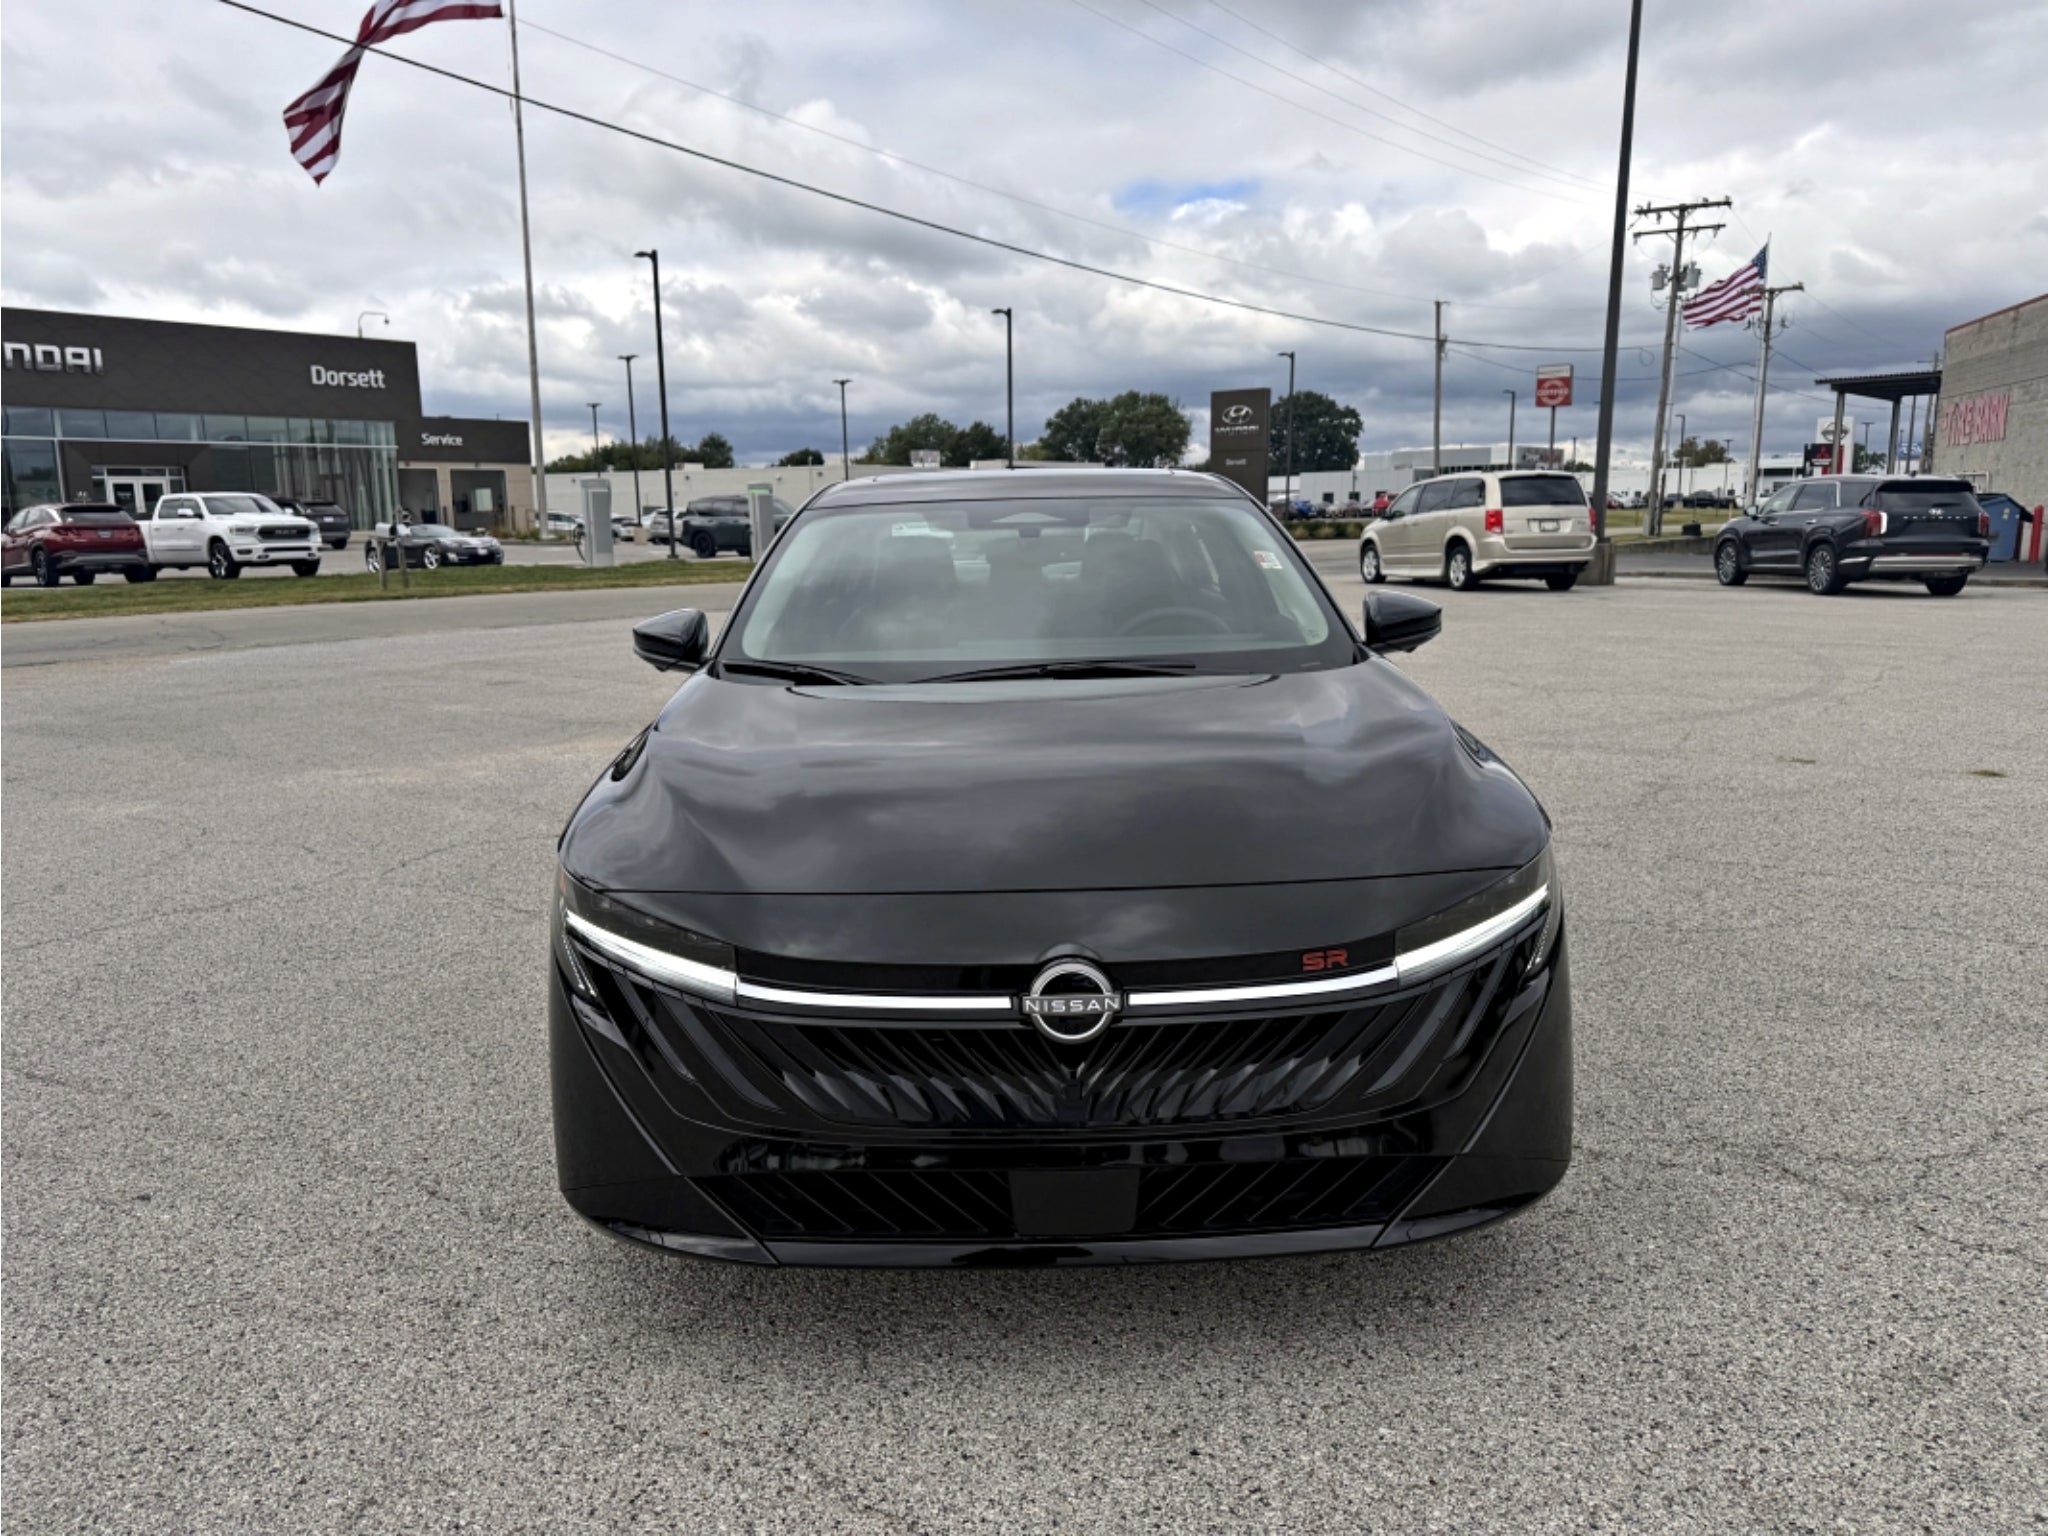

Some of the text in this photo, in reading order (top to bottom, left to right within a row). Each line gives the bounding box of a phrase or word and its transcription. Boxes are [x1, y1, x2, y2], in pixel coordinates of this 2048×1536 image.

[310, 364, 386, 389] Dorsett
[1975, 393, 2008, 444] BARN
[421, 432, 463, 447] Service
[1302, 949, 1348, 971] SR
[1025, 997, 1120, 1013] NISSAN
